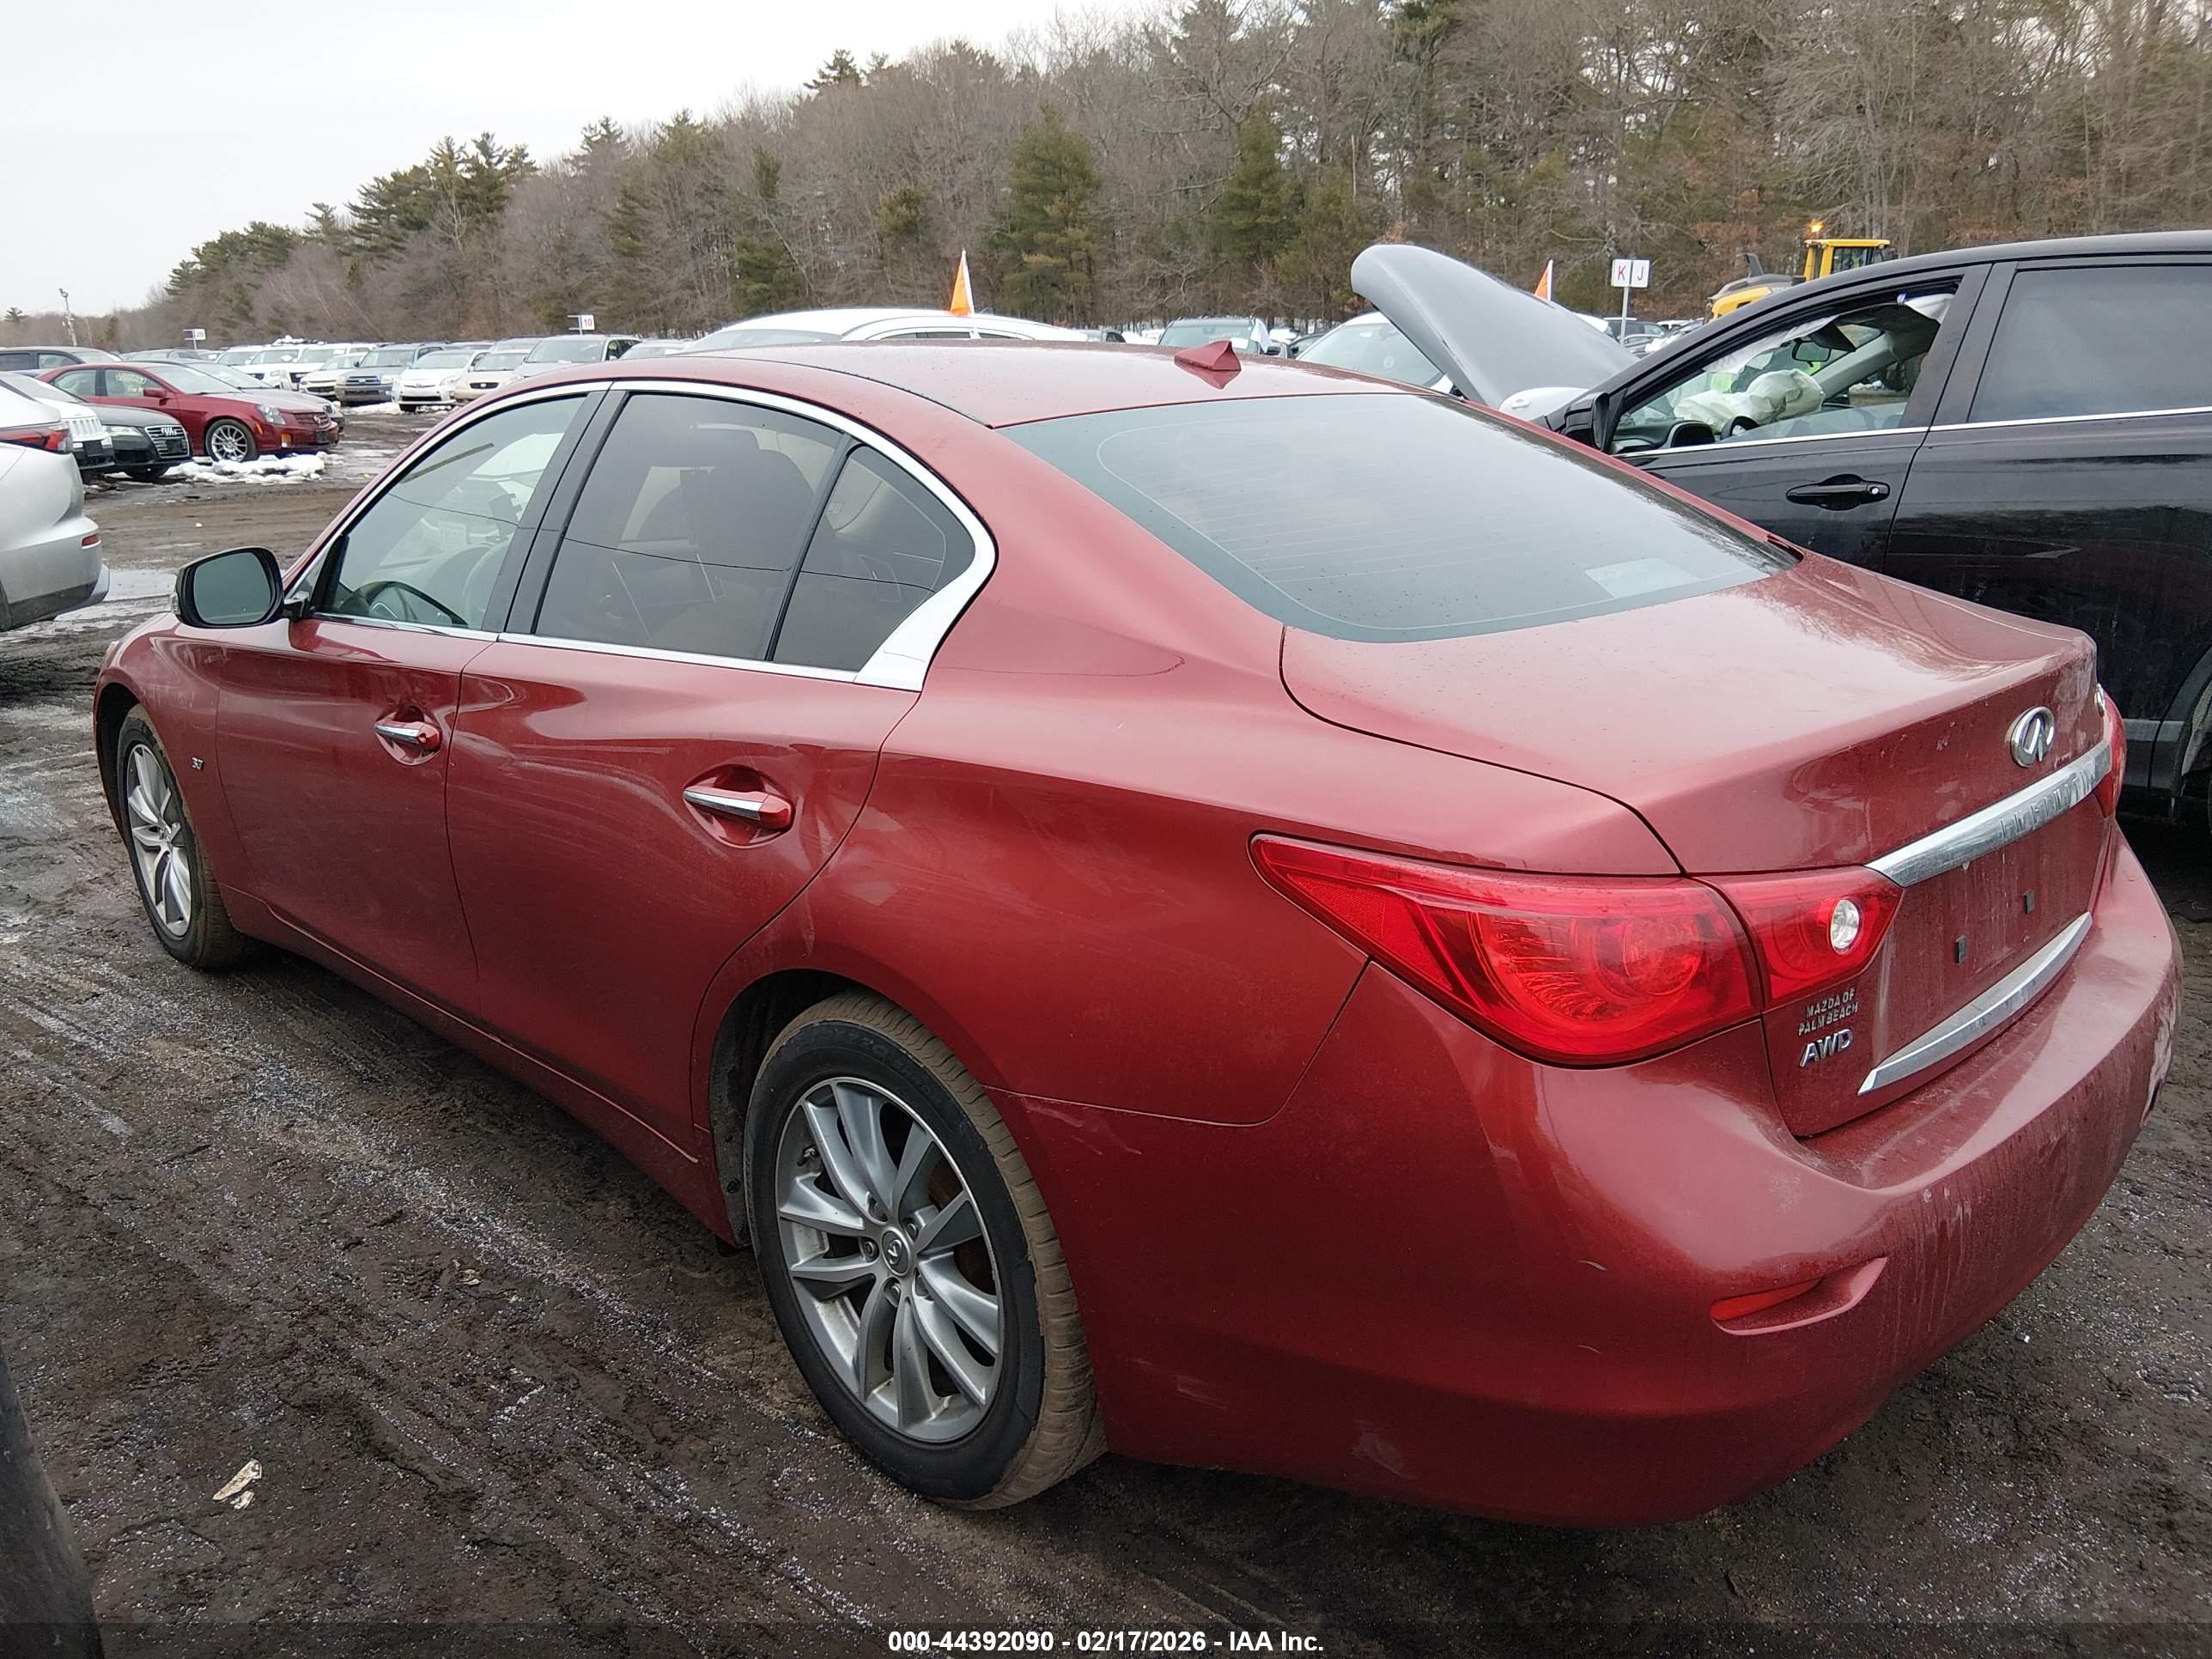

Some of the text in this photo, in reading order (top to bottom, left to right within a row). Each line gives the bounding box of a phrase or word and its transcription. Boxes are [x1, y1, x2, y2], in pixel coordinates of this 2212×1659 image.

[1618, 264, 1627, 282] K
[1637, 264, 1644, 282] J
[1806, 988, 1856, 1018] MAZDA OF
[1798, 1003, 1859, 1036] PALM BEACH
[1799, 1028, 1853, 1067] AWD
